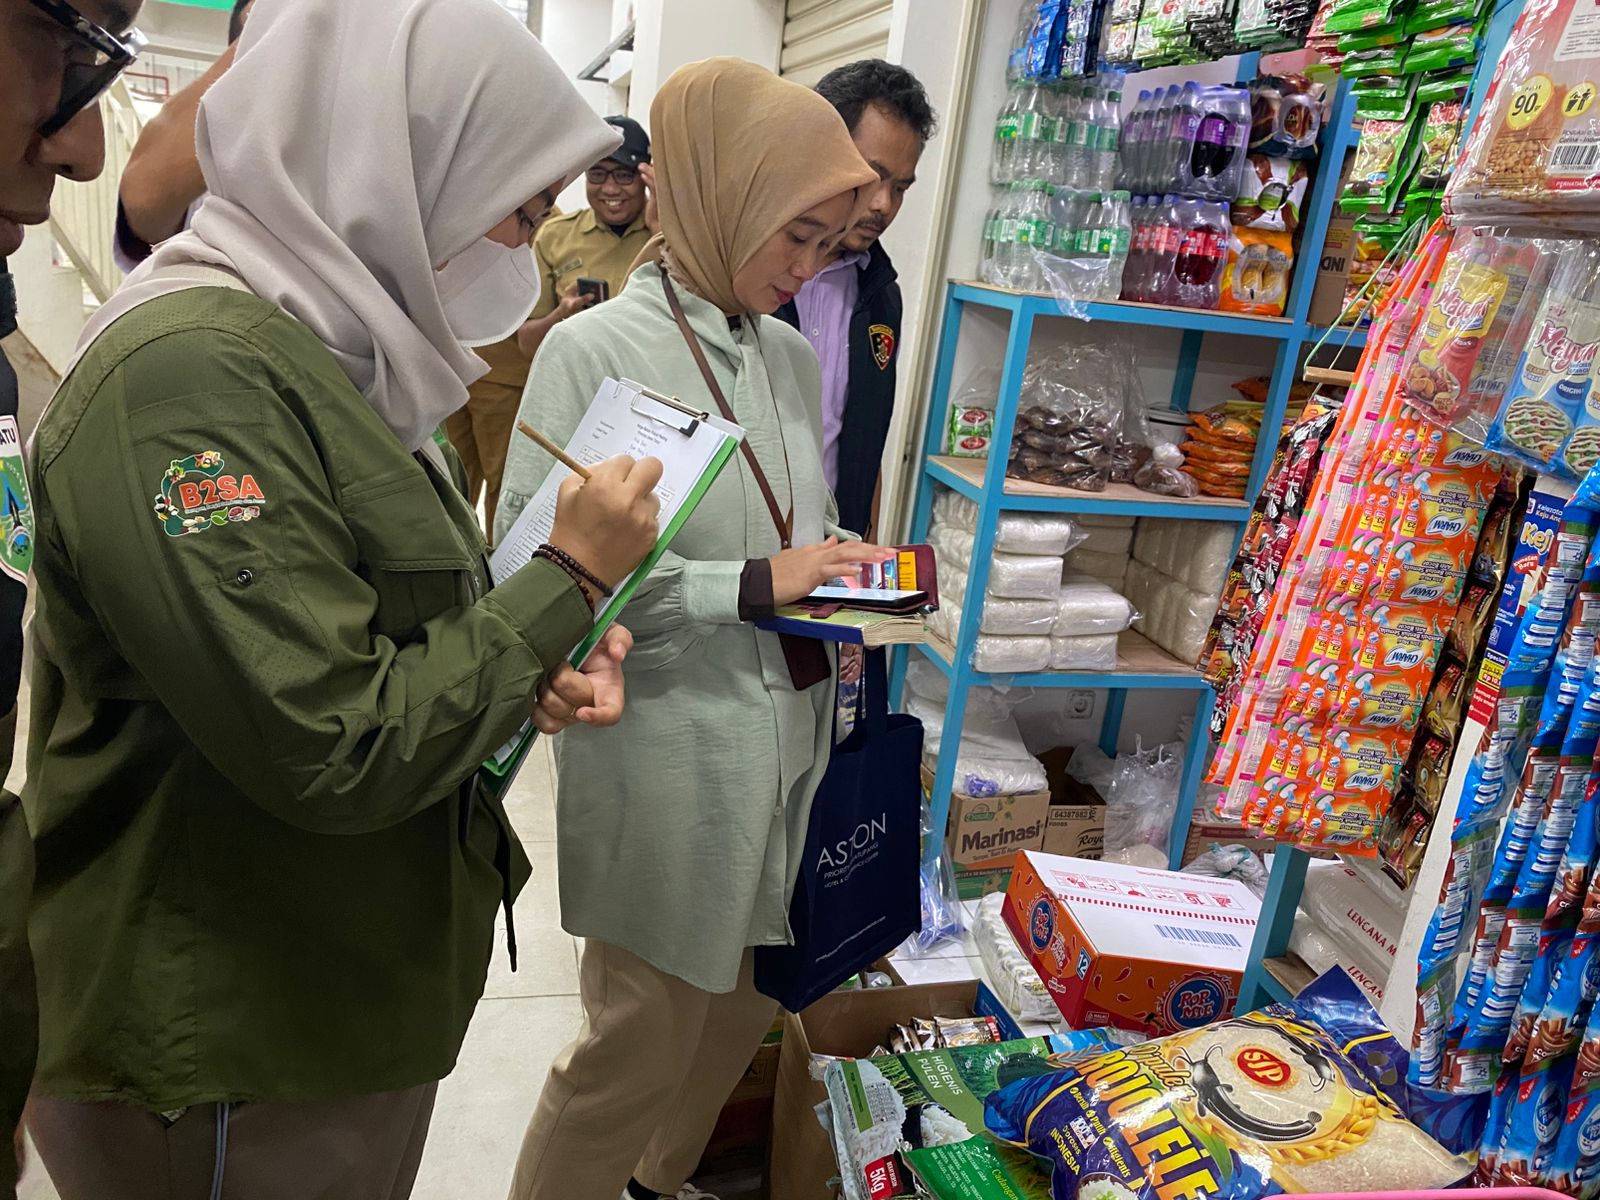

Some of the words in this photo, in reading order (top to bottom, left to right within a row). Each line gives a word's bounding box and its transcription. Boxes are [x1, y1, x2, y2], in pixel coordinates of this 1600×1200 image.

[1511, 92, 1538, 116] 90
[178, 474, 265, 509] B2SA
[1432, 518, 1462, 532] CHARM
[1409, 587, 1438, 599] CHARM
[1391, 651, 1419, 664] CHARM
[1370, 714, 1397, 725] CHARM
[1351, 773, 1379, 785] CHARM
[962, 819, 1041, 853] Marinasi
[1347, 908, 1387, 948] LENCANA
[1077, 951, 1089, 976] 12
[1180, 990, 1211, 1005] POP
[1181, 1003, 1213, 1020] MIE
[918, 1058, 943, 1089] PULEN
[931, 1055, 963, 1096] HIGIENIS
[1051, 1128, 1081, 1175] INDONESIA
[869, 1166, 884, 1194] 5Kg
[990, 1167, 1020, 1200] Cadangan
